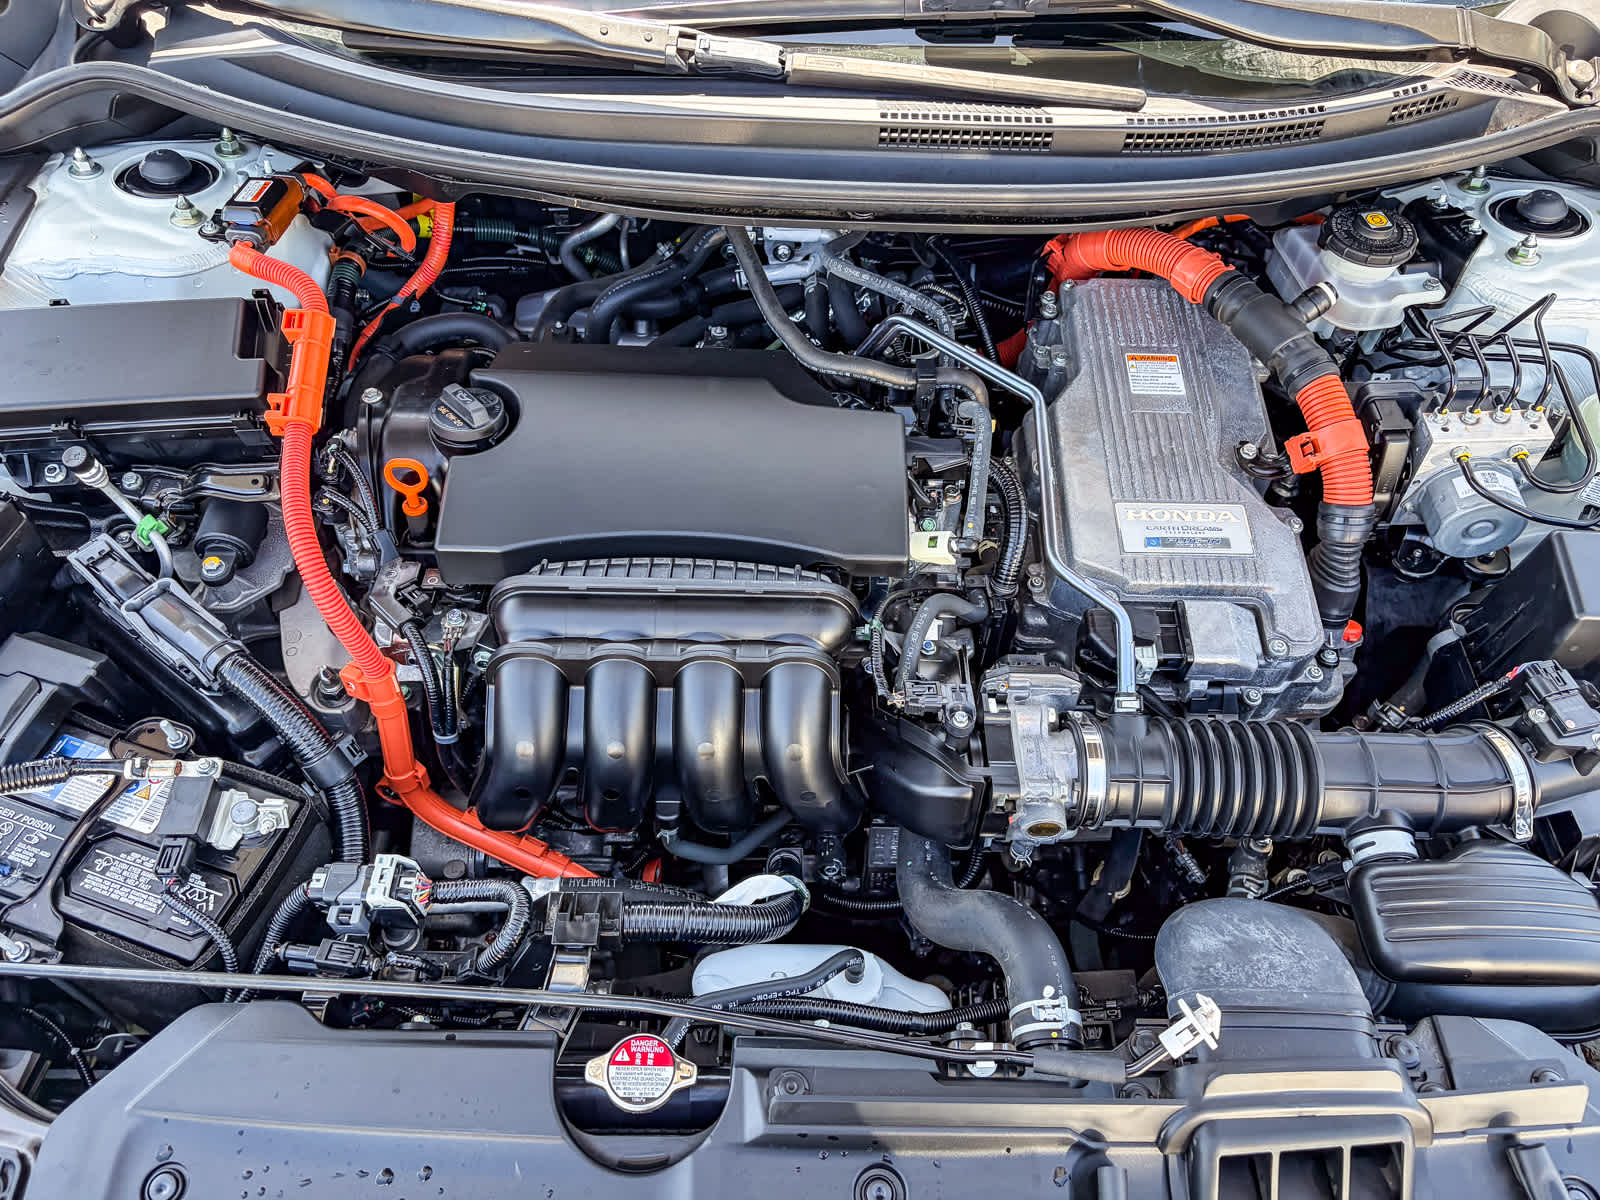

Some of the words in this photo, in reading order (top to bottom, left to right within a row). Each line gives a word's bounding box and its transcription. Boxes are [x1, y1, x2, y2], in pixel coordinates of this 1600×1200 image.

[1125, 508, 1241, 522] HONDA
[568, 878, 617, 889] HYLAMMIT
[785, 988, 801, 997] TPC
